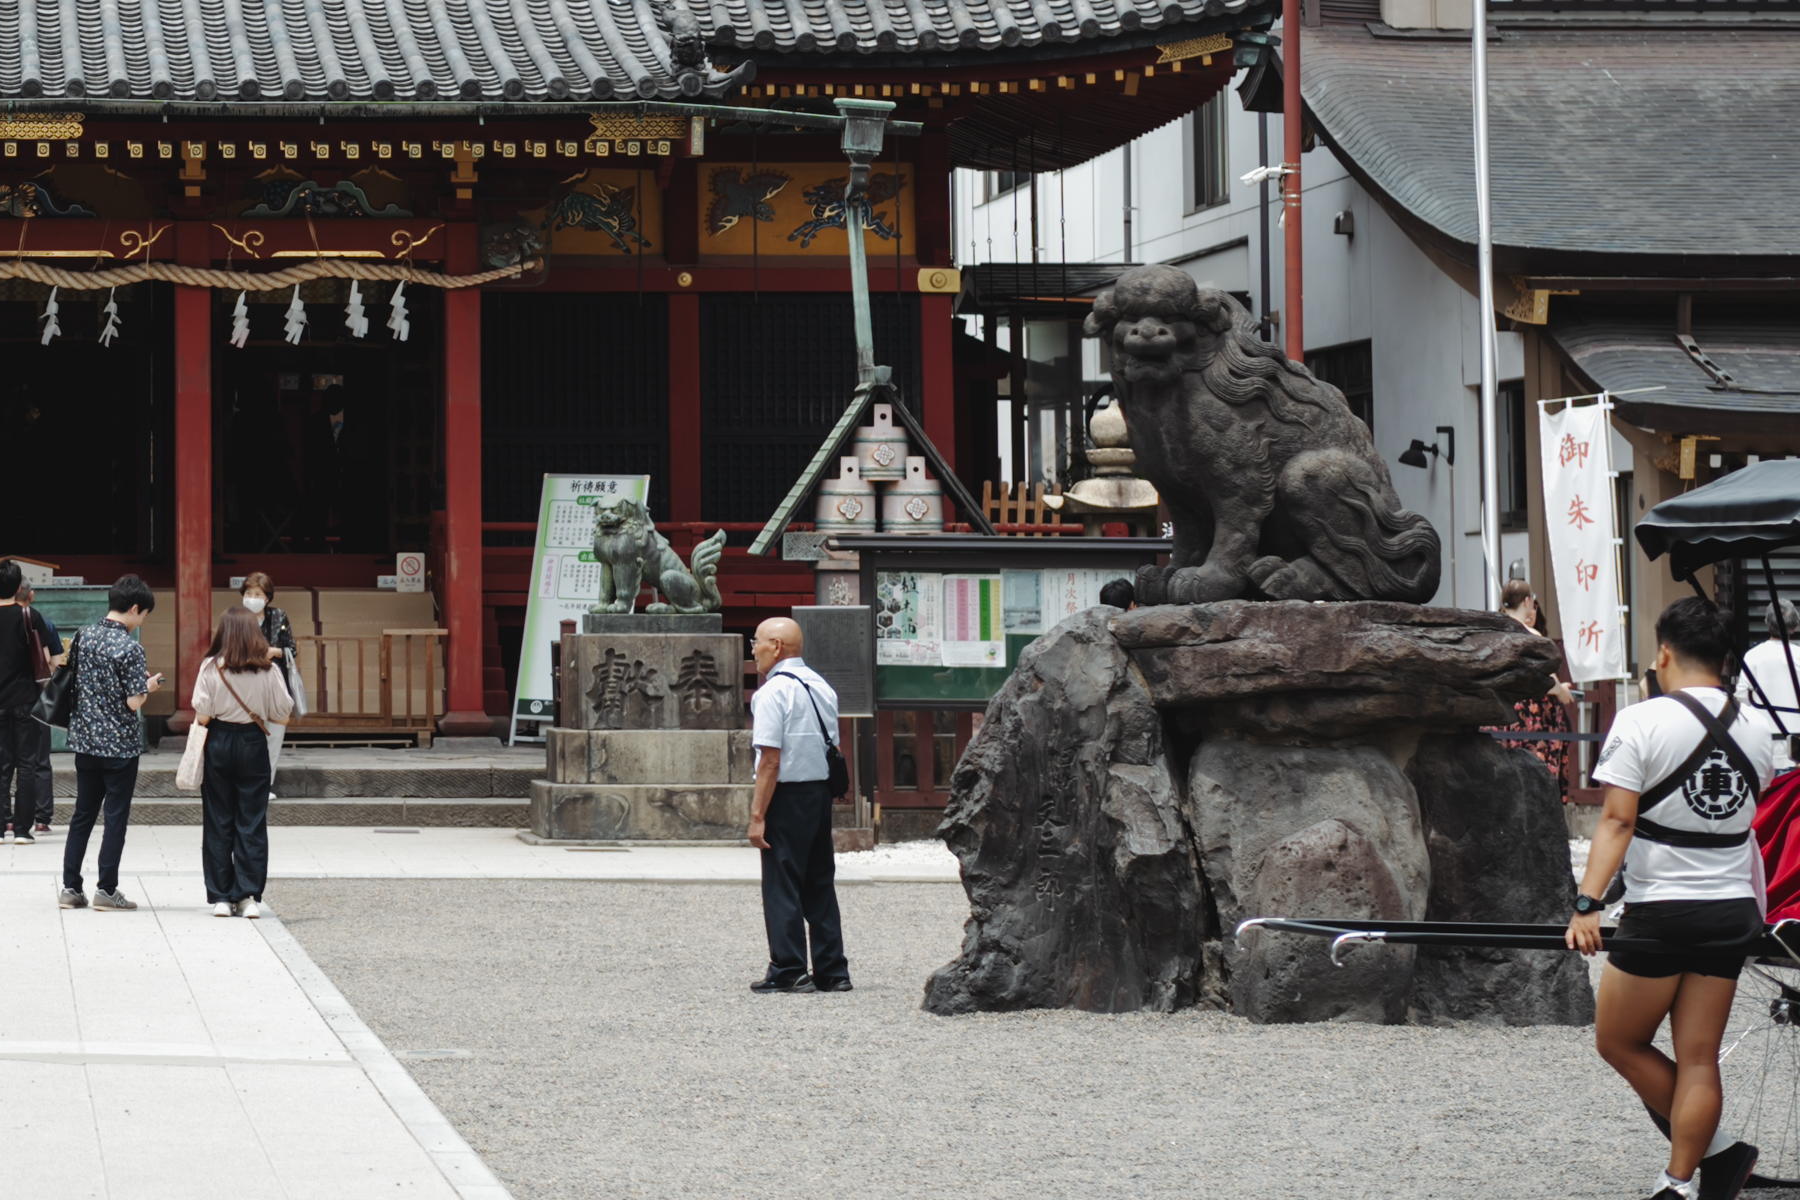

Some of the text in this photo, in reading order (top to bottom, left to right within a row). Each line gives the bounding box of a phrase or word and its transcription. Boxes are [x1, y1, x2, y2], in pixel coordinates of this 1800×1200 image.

[1557, 432, 1605, 654] 御朱印所
[1065, 572, 1078, 614] 月次祭
[1700, 763, 1733, 802] 車
